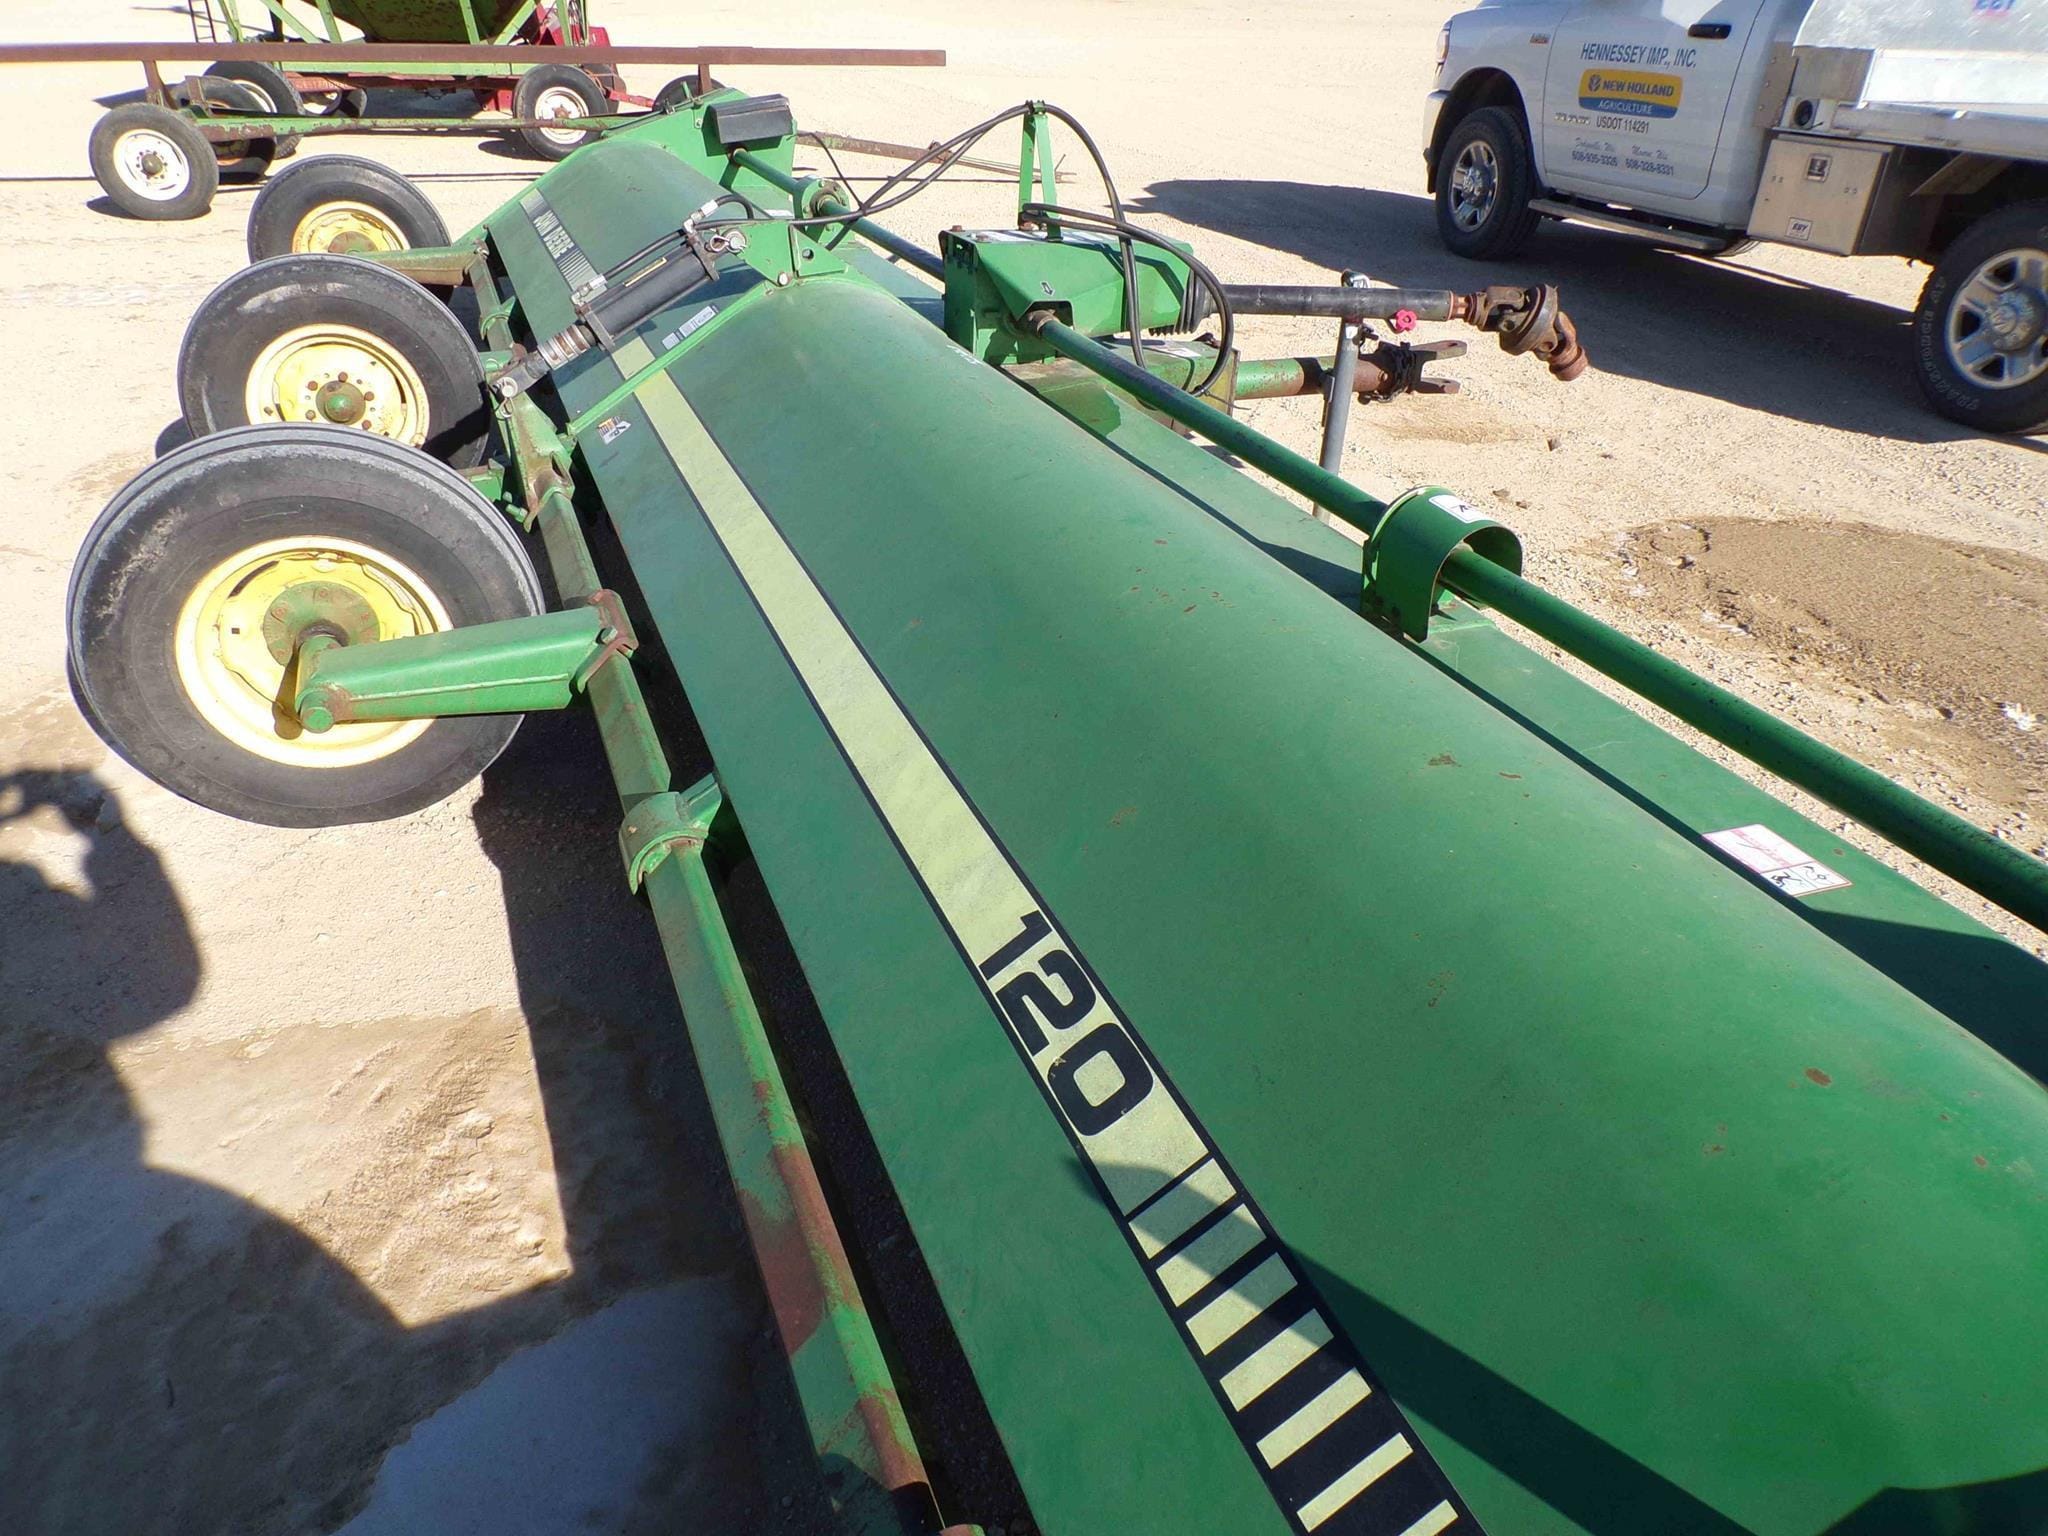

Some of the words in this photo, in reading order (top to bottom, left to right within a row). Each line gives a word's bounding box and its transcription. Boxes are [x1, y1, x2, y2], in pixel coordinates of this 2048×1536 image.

[1580, 43, 1647, 64] HENNESSEY
[1646, 46, 1670, 69] IMP.,
[1673, 49, 1697, 68] INC.
[1602, 80, 1625, 91] NEW
[1627, 82, 1674, 97] HOLLAND
[1599, 100, 1652, 114] AGRICULTURE
[1596, 117, 1622, 130] USDOT
[1624, 119, 1650, 134] 114291
[543, 225, 576, 260] DEERE
[978, 909, 1154, 1136] 120
